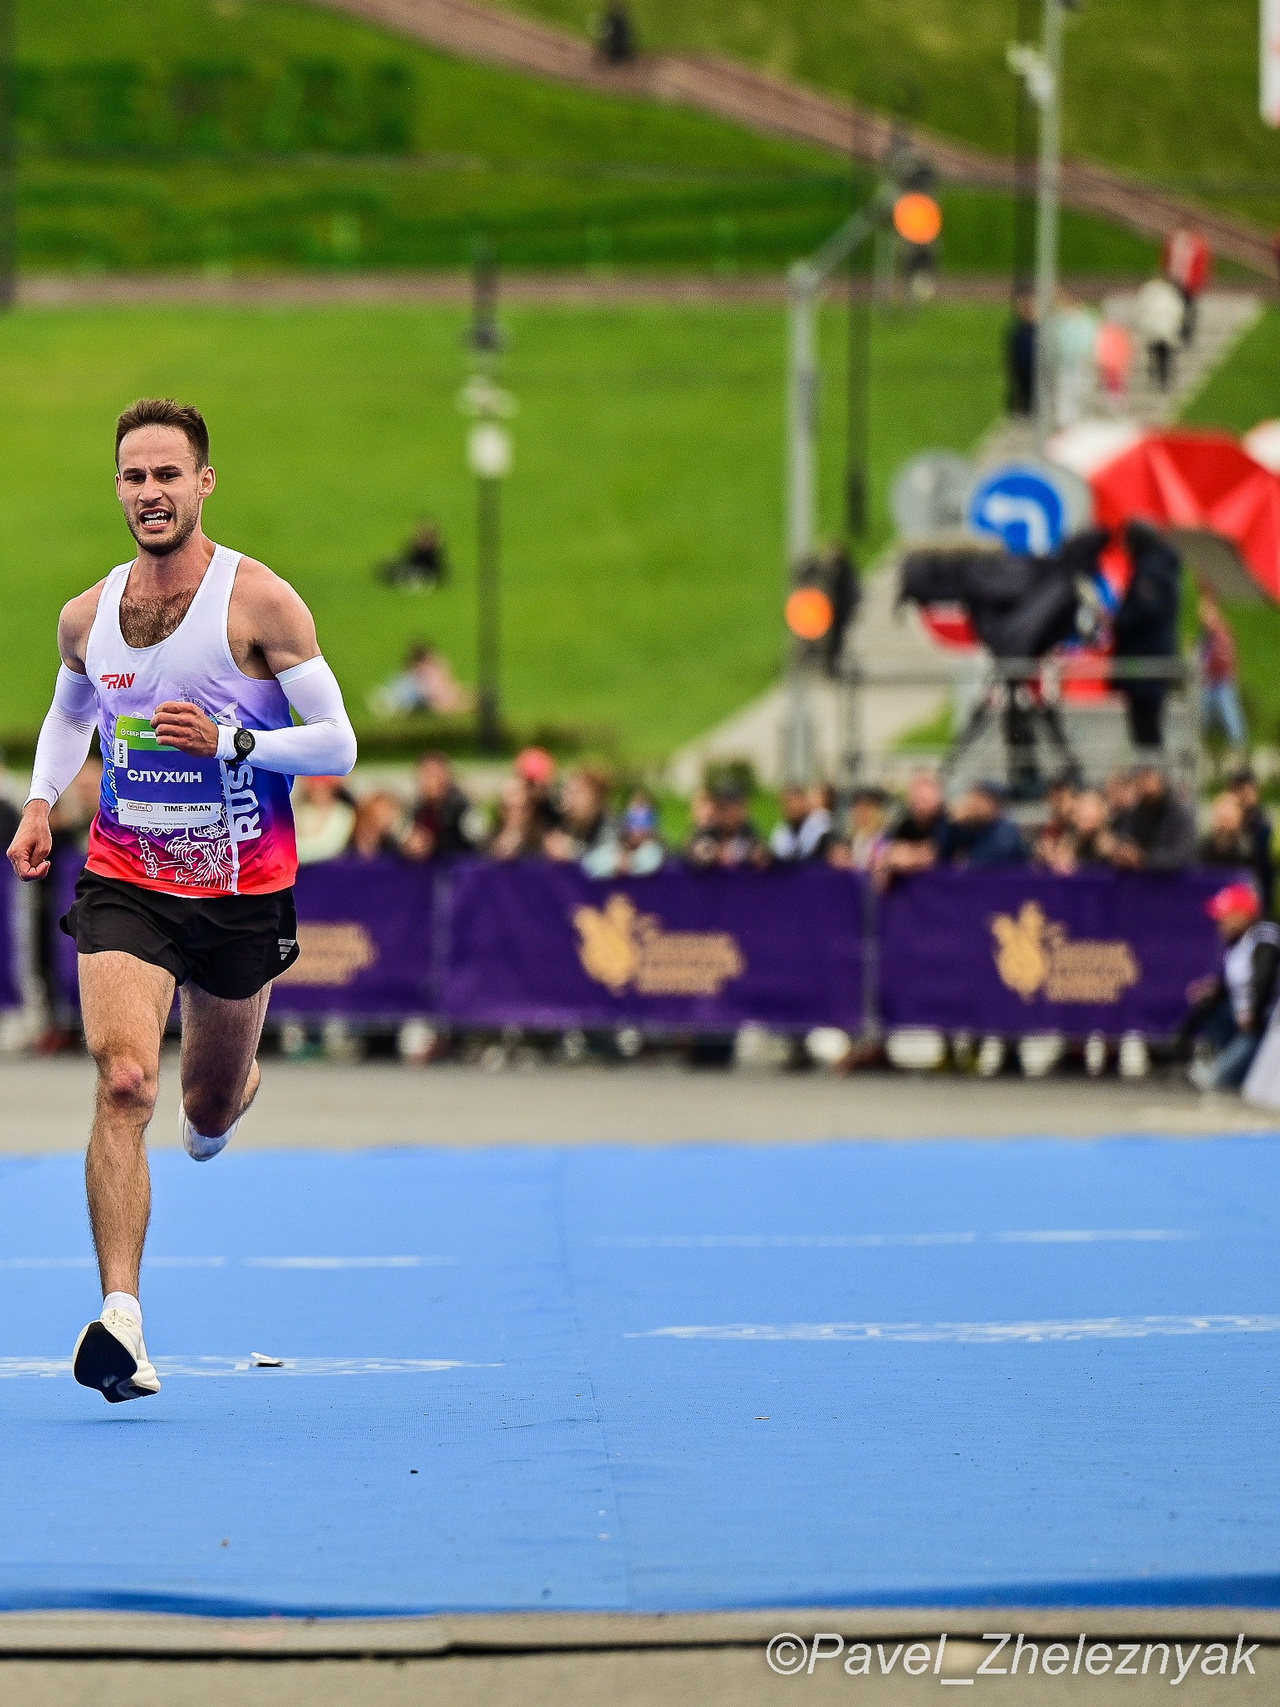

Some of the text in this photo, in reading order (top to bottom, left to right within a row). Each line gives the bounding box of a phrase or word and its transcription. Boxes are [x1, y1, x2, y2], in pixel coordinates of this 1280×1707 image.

[100, 673, 136, 690] RAV
[126, 769, 203, 784] СЛУХИН
[215, 701, 262, 842] RUSA
